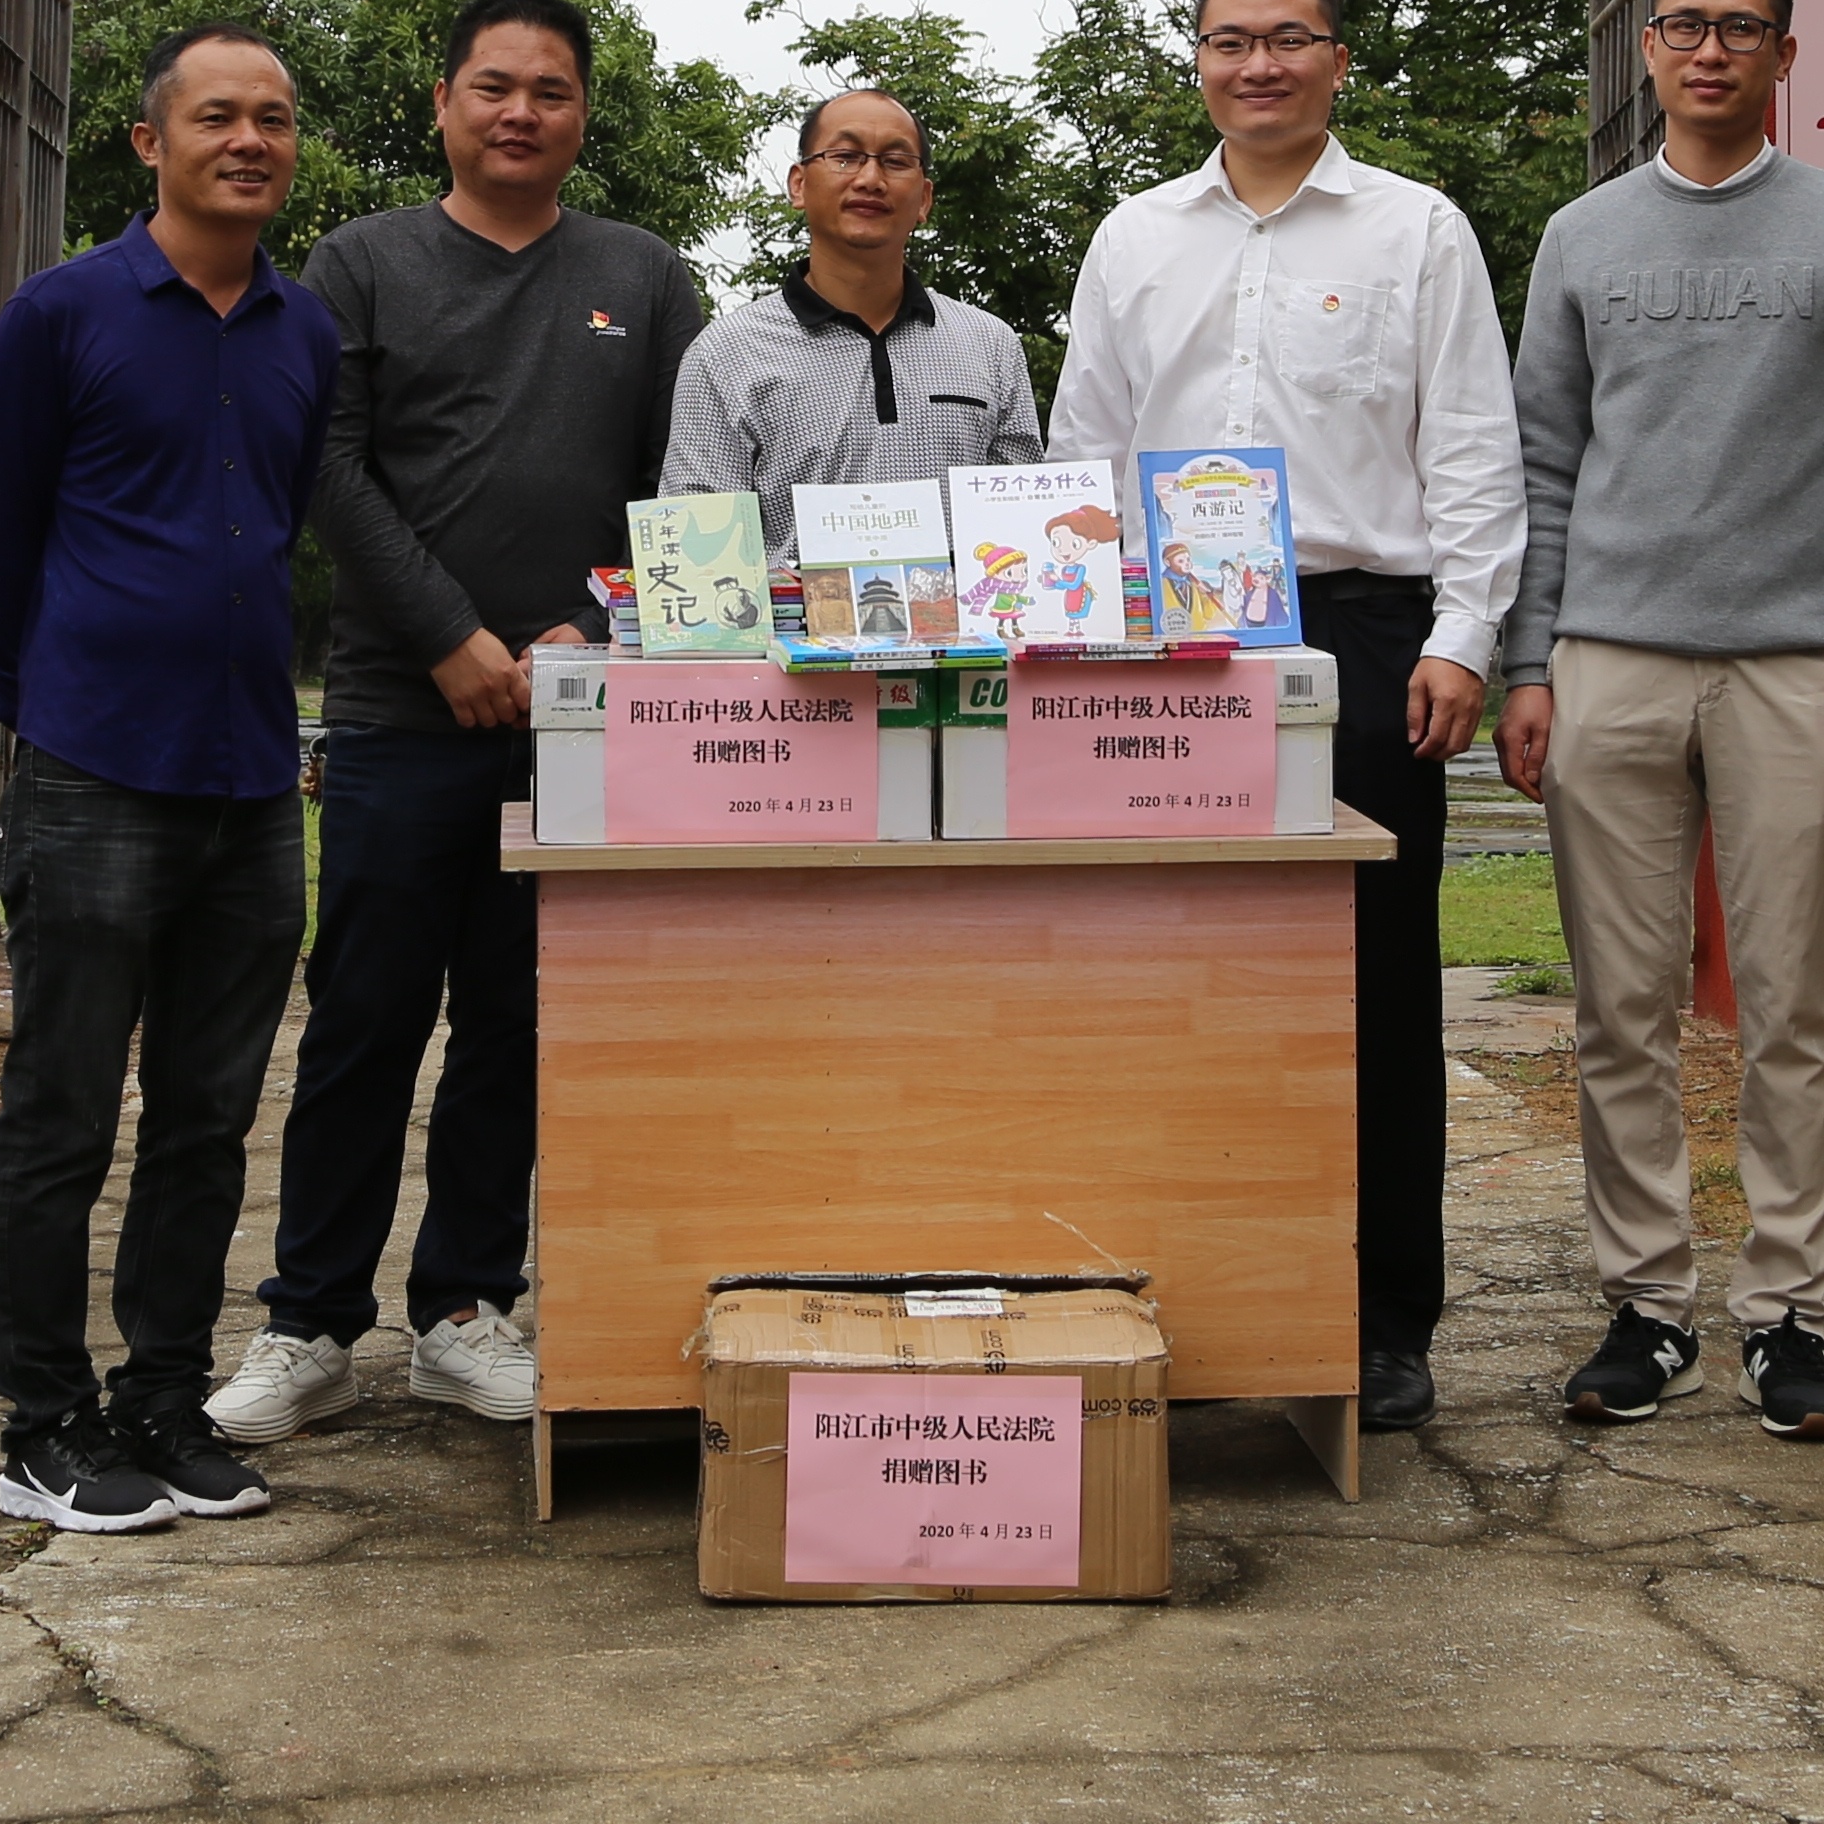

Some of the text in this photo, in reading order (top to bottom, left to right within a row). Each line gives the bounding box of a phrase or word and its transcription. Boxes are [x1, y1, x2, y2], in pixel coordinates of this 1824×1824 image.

[1598, 264, 1816, 324] HUMAN
[967, 471, 1098, 493] 十万个为什么
[822, 509, 921, 533] 中国地理
[1192, 499, 1246, 518] 西游记
[630, 698, 854, 724] 阳江市中级人民法院
[1032, 694, 1253, 720] 阳江市中级人民法院
[692, 738, 792, 764] 捐赠图书
[1092, 734, 1192, 760] 捐赠图书
[815, 1413, 1057, 1444] 阳江市中级人民法院
[881, 1458, 988, 1486] 捐赠图书
